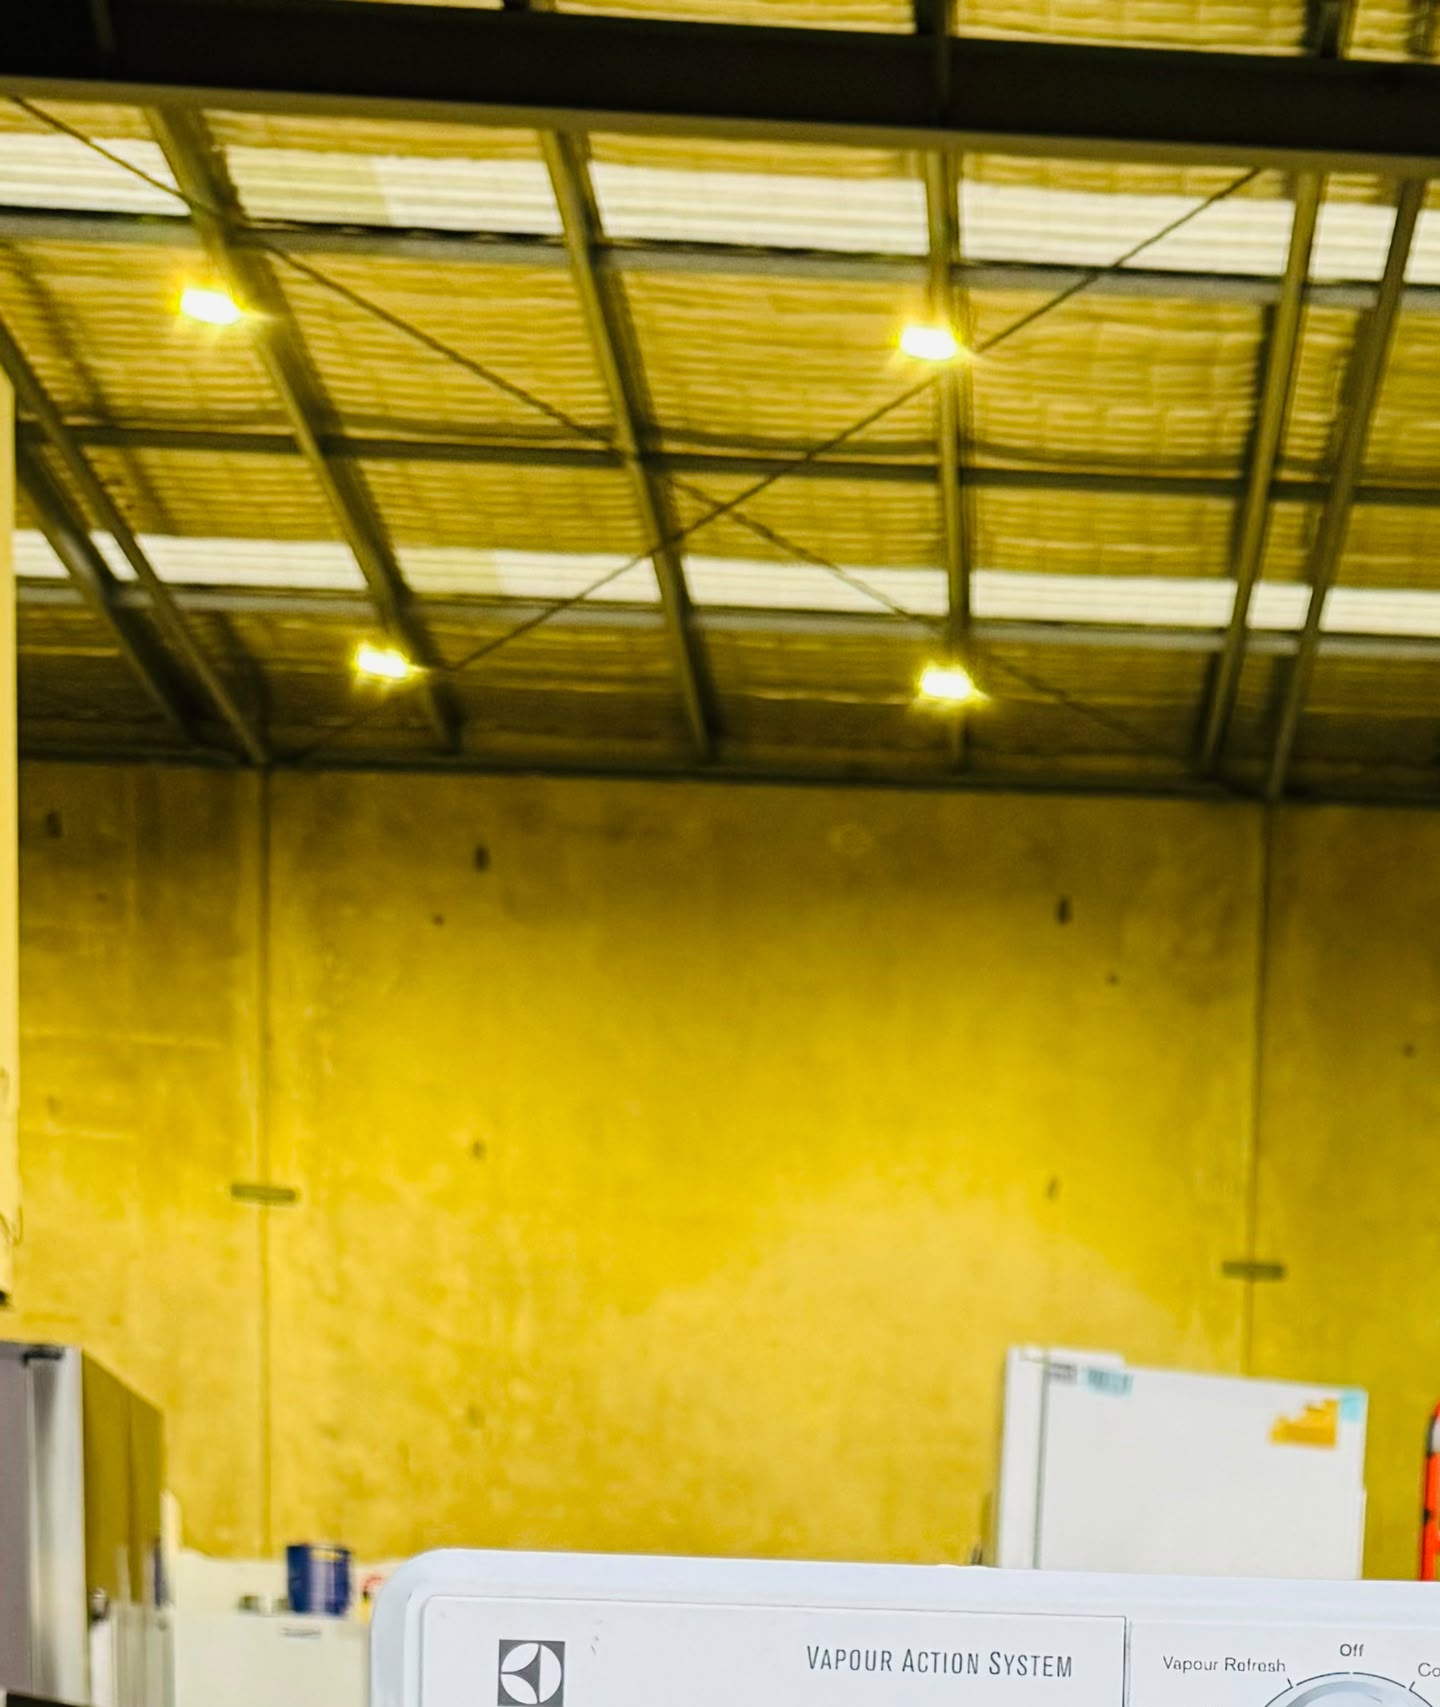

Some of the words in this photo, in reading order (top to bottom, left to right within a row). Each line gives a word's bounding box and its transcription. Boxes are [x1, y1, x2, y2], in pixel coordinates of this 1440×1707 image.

[1339, 1643, 1363, 1657] Off
[807, 1644, 892, 1674] VAPOUR
[902, 1647, 979, 1676] ACTION
[988, 1649, 1073, 1678] SYSTEM
[1163, 1656, 1218, 1673] Vapour
[1225, 1658, 1286, 1673] Refresh
